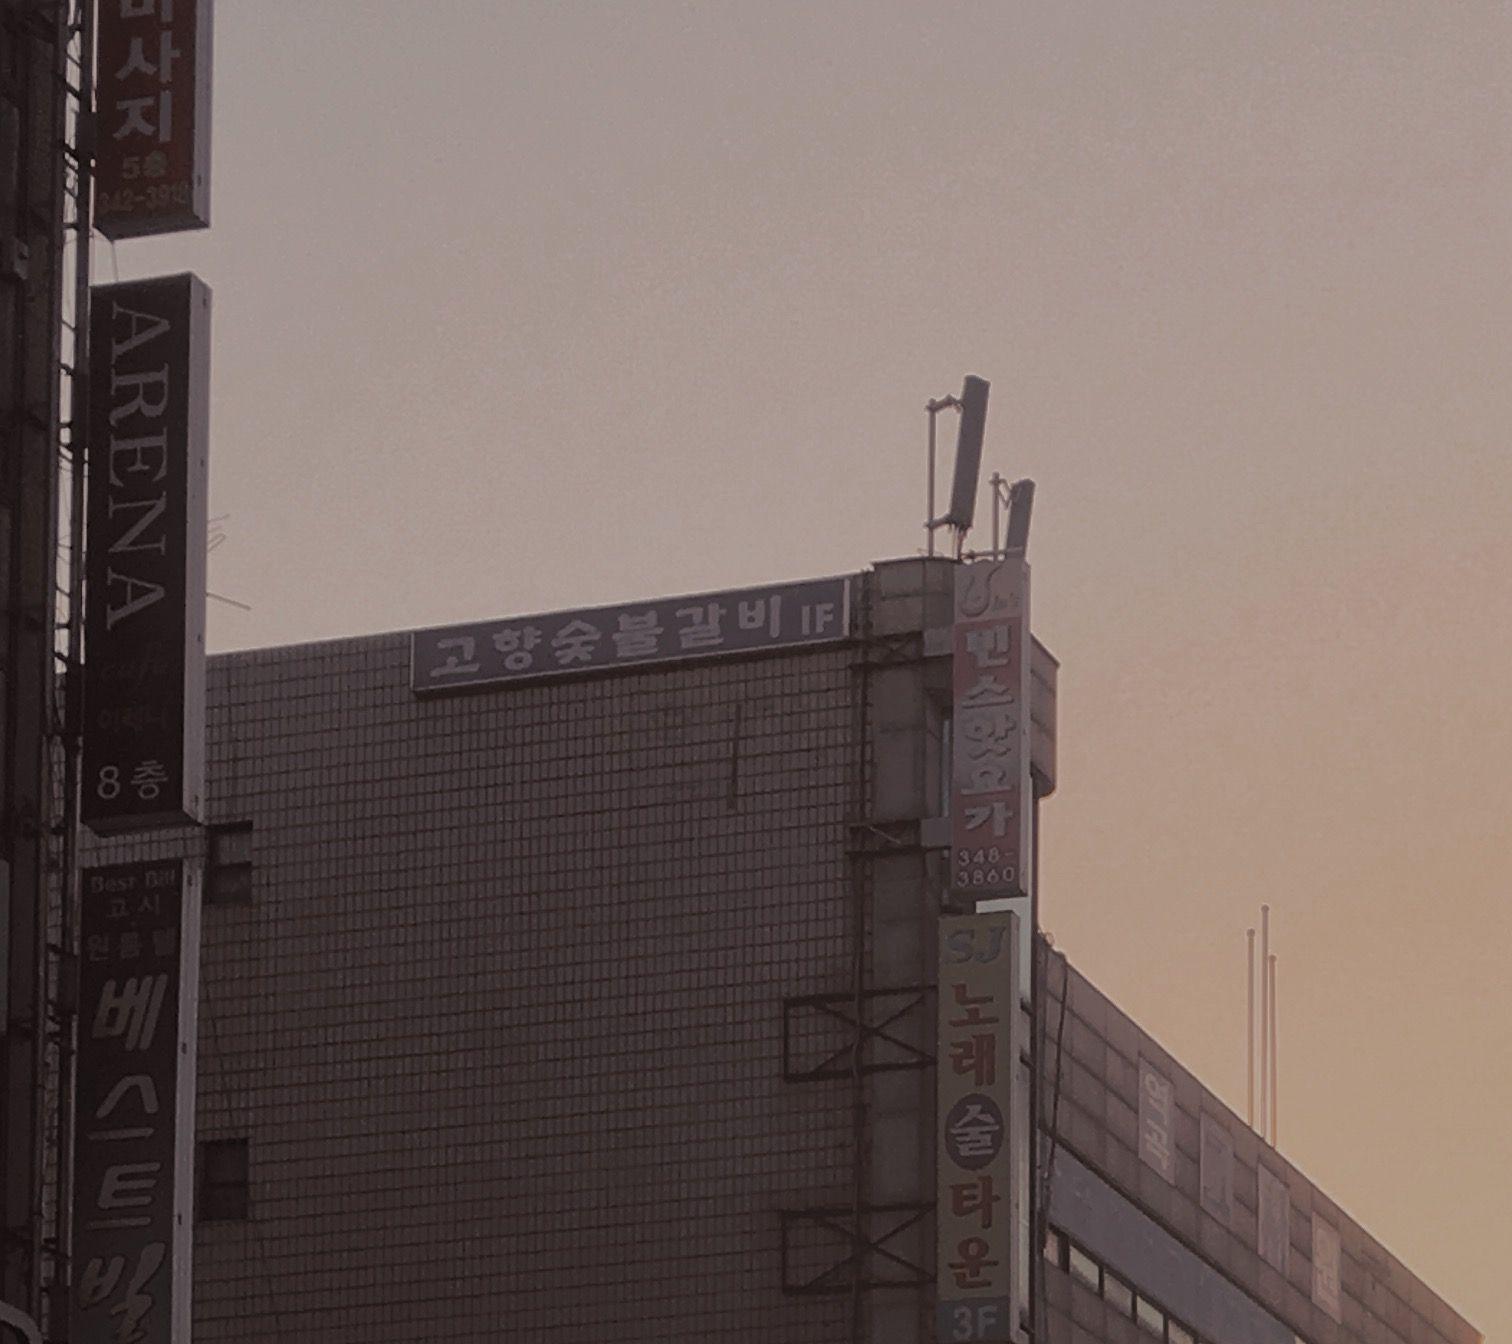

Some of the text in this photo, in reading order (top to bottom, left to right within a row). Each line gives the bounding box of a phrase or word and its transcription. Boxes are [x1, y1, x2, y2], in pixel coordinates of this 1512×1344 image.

[108, 302, 171, 632] ARENA
[429, 594, 782, 679] 고향숯불갈비
[97, 760, 169, 799] 8층
[951, 1305, 998, 1342] 3F
